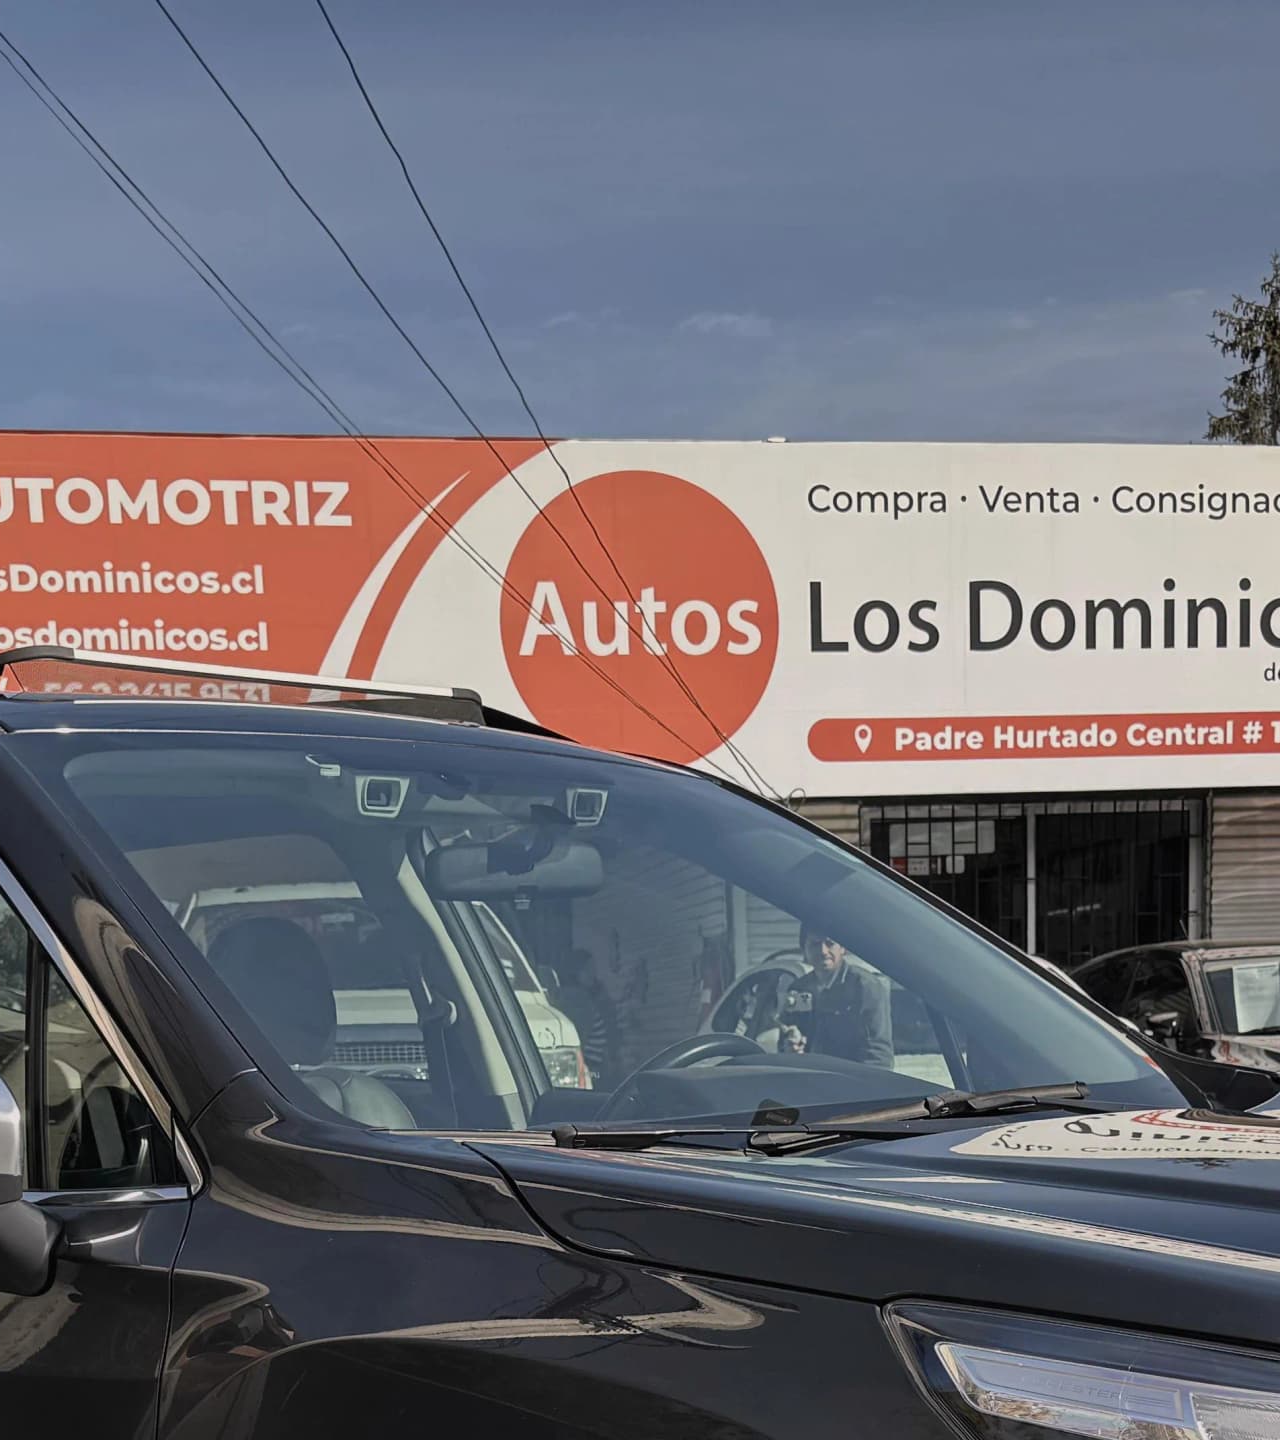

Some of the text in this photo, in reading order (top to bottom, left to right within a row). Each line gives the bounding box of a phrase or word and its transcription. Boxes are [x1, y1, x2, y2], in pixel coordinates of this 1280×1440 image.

[807, 484, 947, 521] Compra
[978, 485, 1080, 514] Venta
[518, 580, 763, 656] Autos
[808, 580, 940, 654] Los
[894, 725, 986, 753] Padre
[992, 723, 1119, 750] Hurtado
[1126, 720, 1235, 748] Central
[1242, 721, 1264, 745] #
